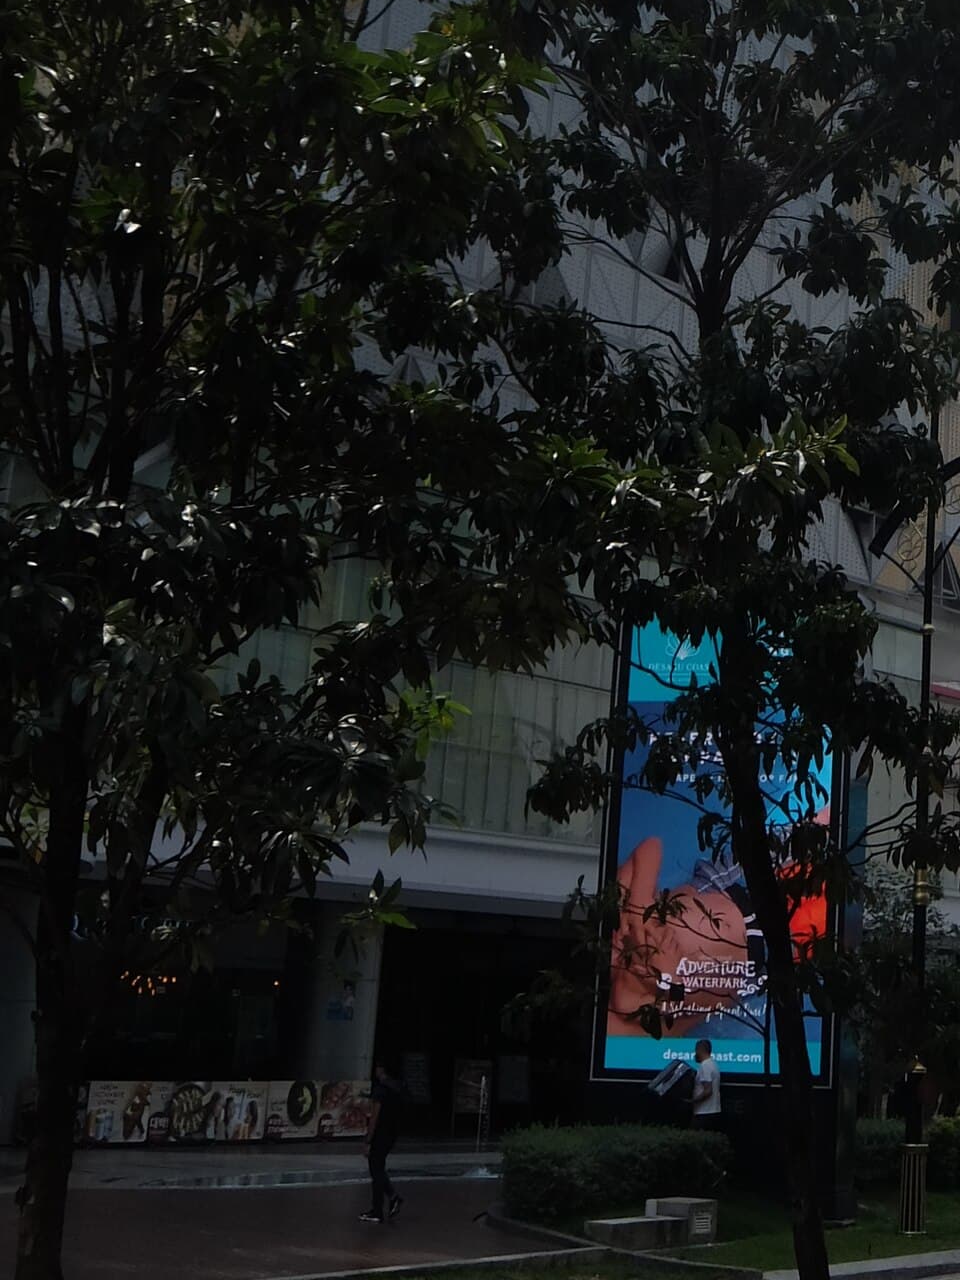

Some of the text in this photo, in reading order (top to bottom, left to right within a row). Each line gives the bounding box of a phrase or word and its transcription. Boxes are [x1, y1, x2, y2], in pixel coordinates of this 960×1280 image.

[686, 663, 714, 671] COAS
[675, 957, 757, 977] ADVENTURE
[681, 975, 749, 989] WATERPARK
[663, 1048, 762, 1063] desarast.com
